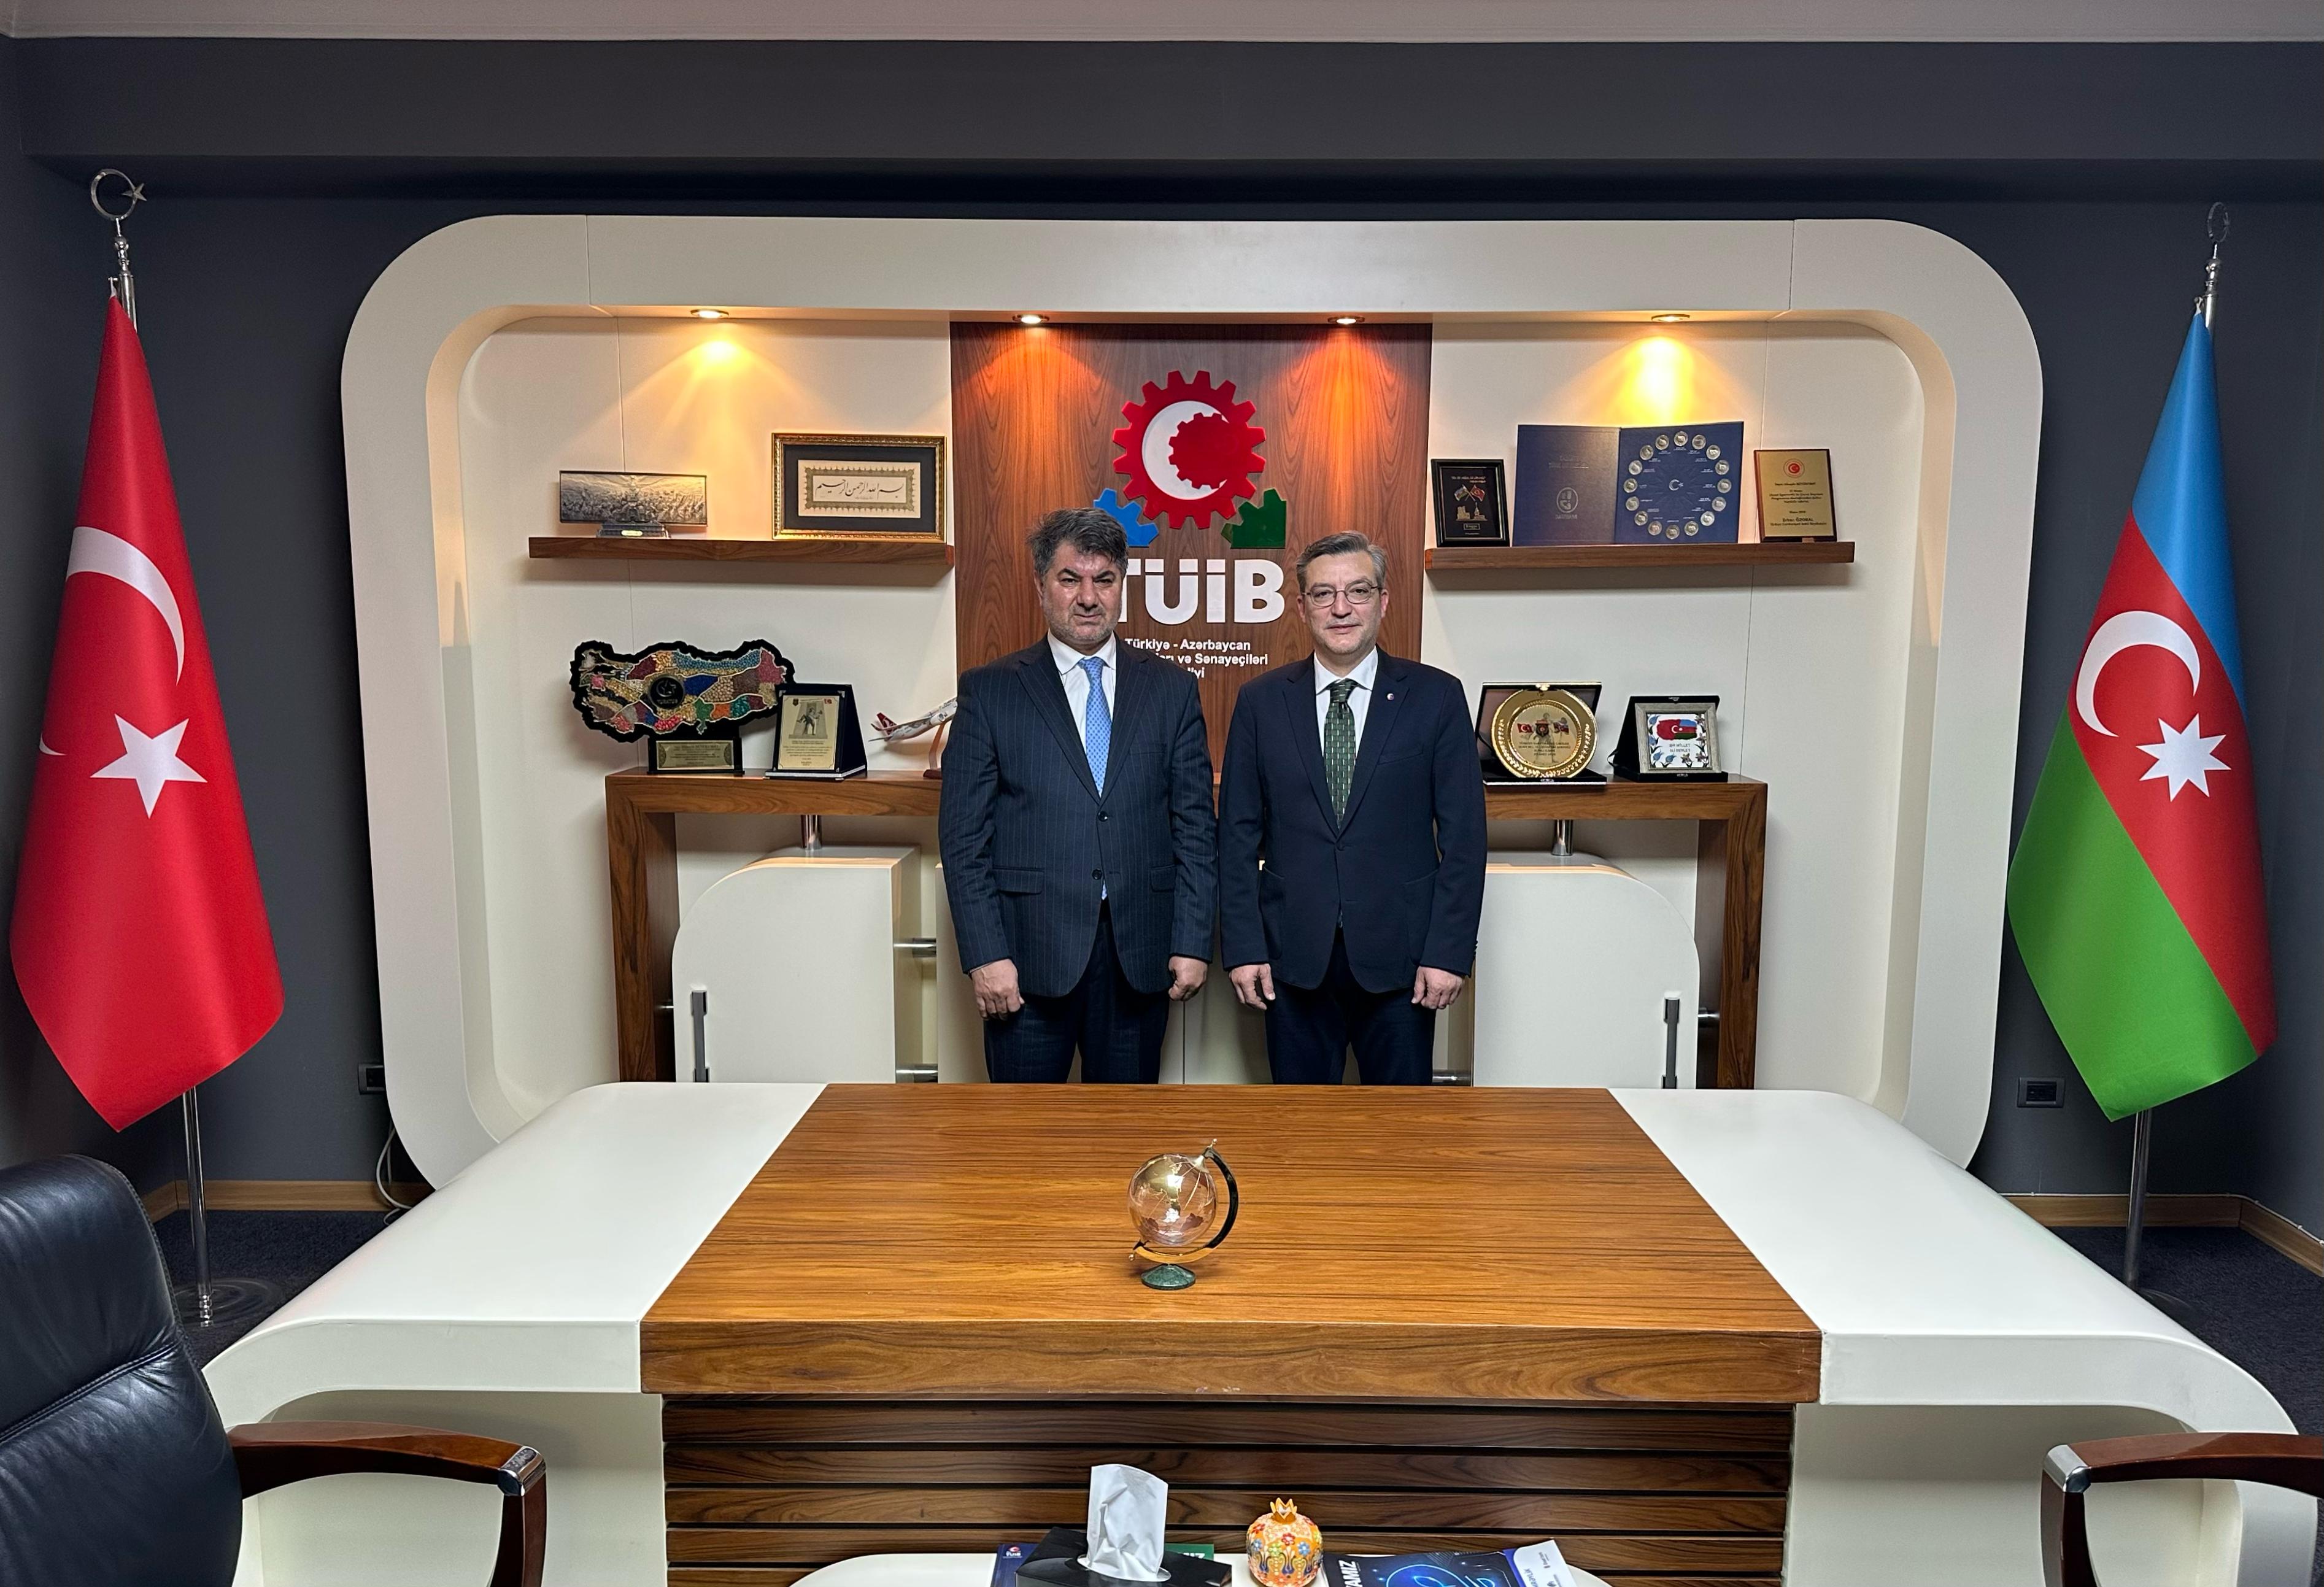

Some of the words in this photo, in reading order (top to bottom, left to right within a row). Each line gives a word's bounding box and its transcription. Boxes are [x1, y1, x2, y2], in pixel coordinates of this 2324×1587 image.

[1118, 558, 1285, 625] ÜİB
[1125, 638, 1170, 650] Türkiyə
[1180, 639, 1251, 652] Azərbaycan
[1195, 654, 1268, 666] Sənayeçiləri
[1338, 1560, 1363, 1587] AMIZ
